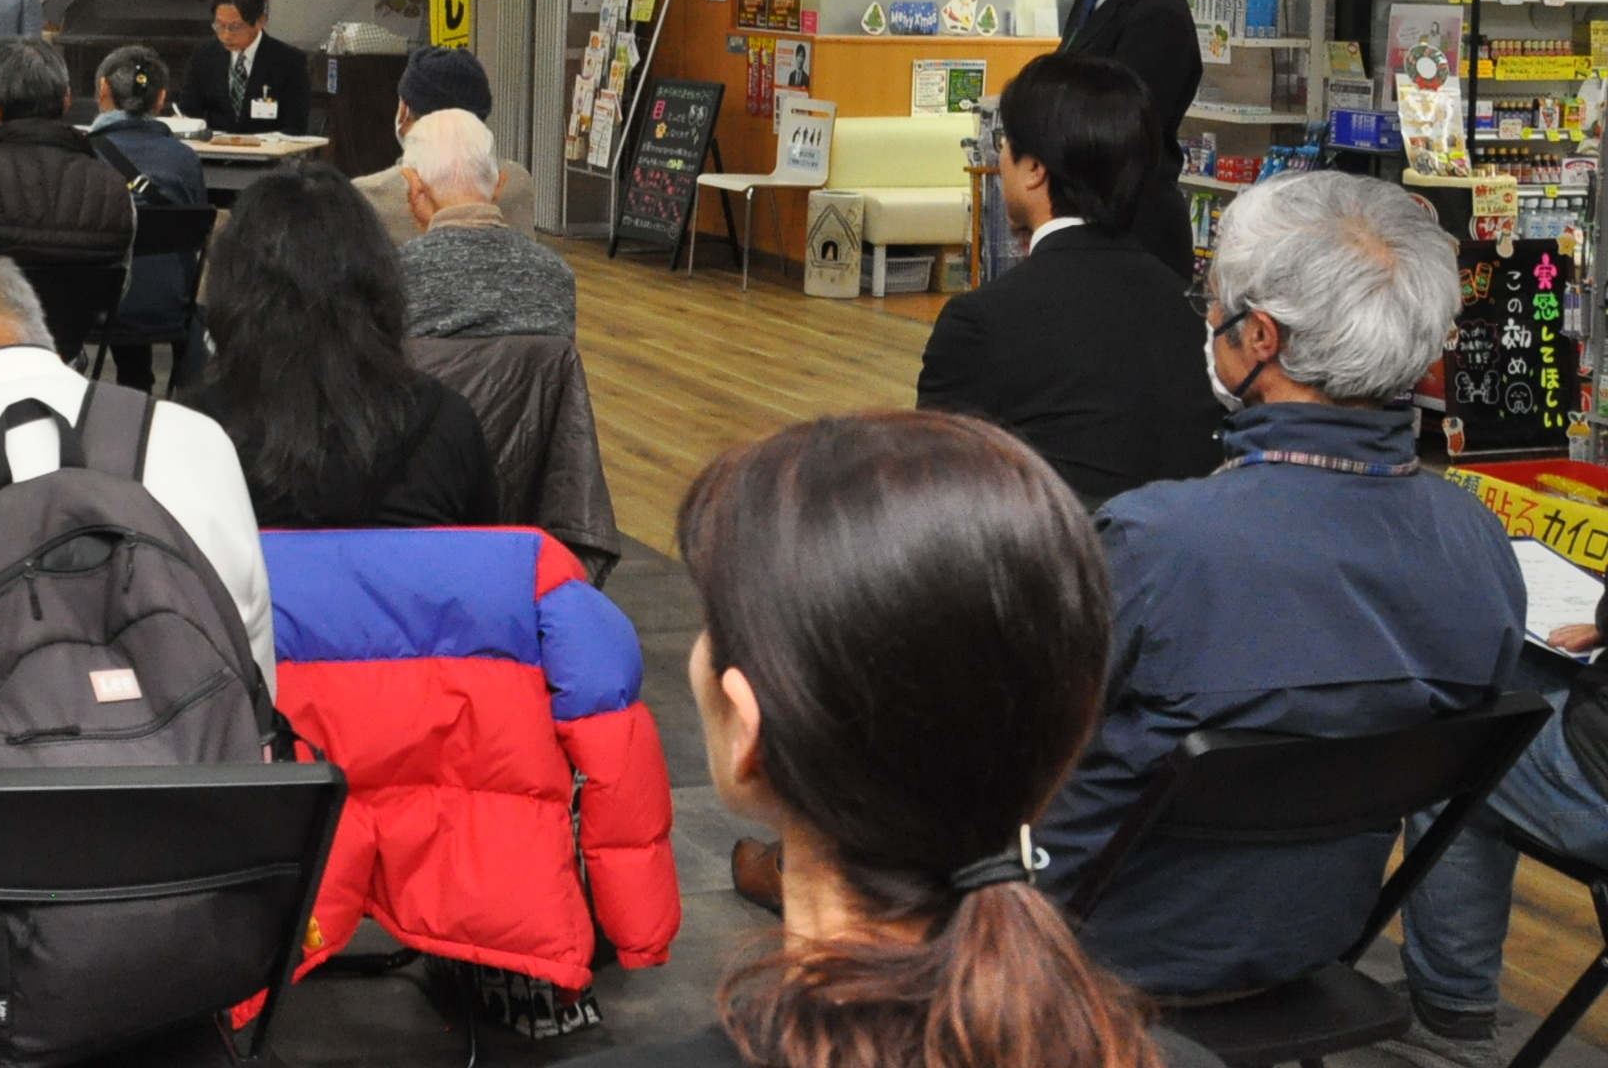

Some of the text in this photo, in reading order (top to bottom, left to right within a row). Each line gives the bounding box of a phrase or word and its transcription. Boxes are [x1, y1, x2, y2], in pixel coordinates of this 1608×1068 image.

[891, 12, 914, 29] Merry
[1533, 253, 1564, 428] 実感してほしい
[99, 674, 135, 695] Lee
